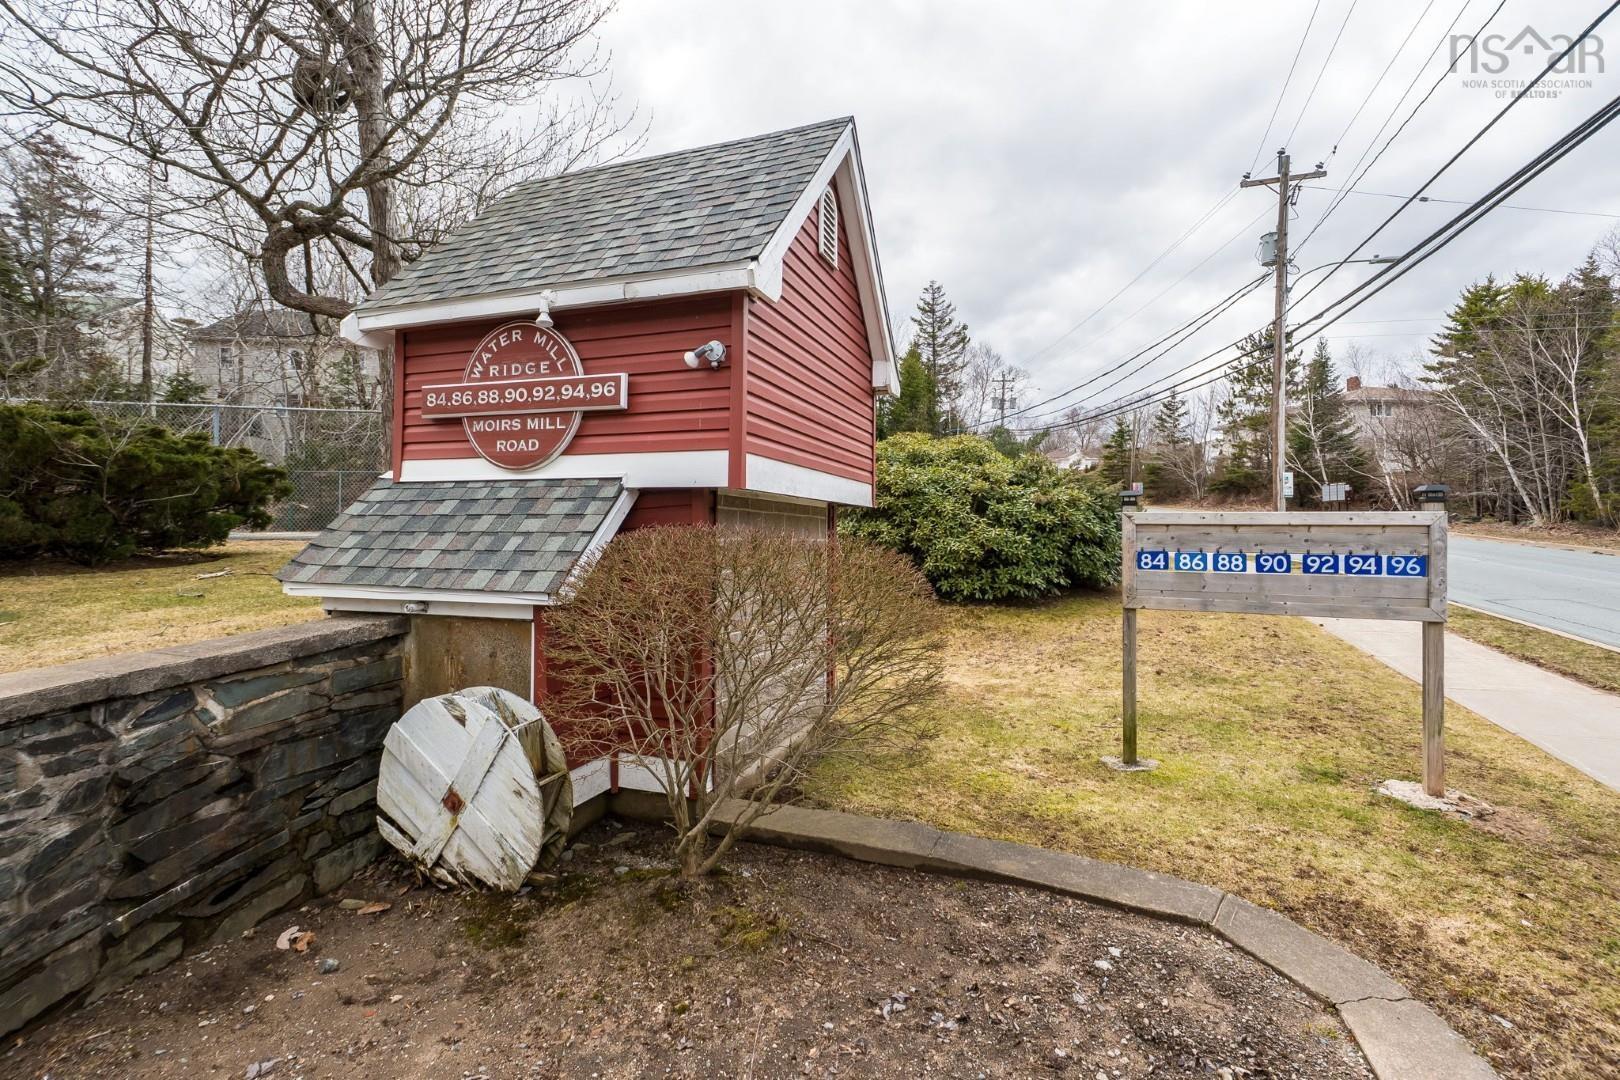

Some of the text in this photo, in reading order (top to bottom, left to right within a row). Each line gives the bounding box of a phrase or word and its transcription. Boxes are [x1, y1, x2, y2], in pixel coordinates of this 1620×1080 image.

[471, 329, 568, 379] WATER MILL
[489, 361, 550, 377] RIDGE
[472, 417, 566, 433] MOIRS MILL
[496, 439, 539, 452] ROAD
[1140, 553, 1421, 575] 84 86 88 90 92 94 96
